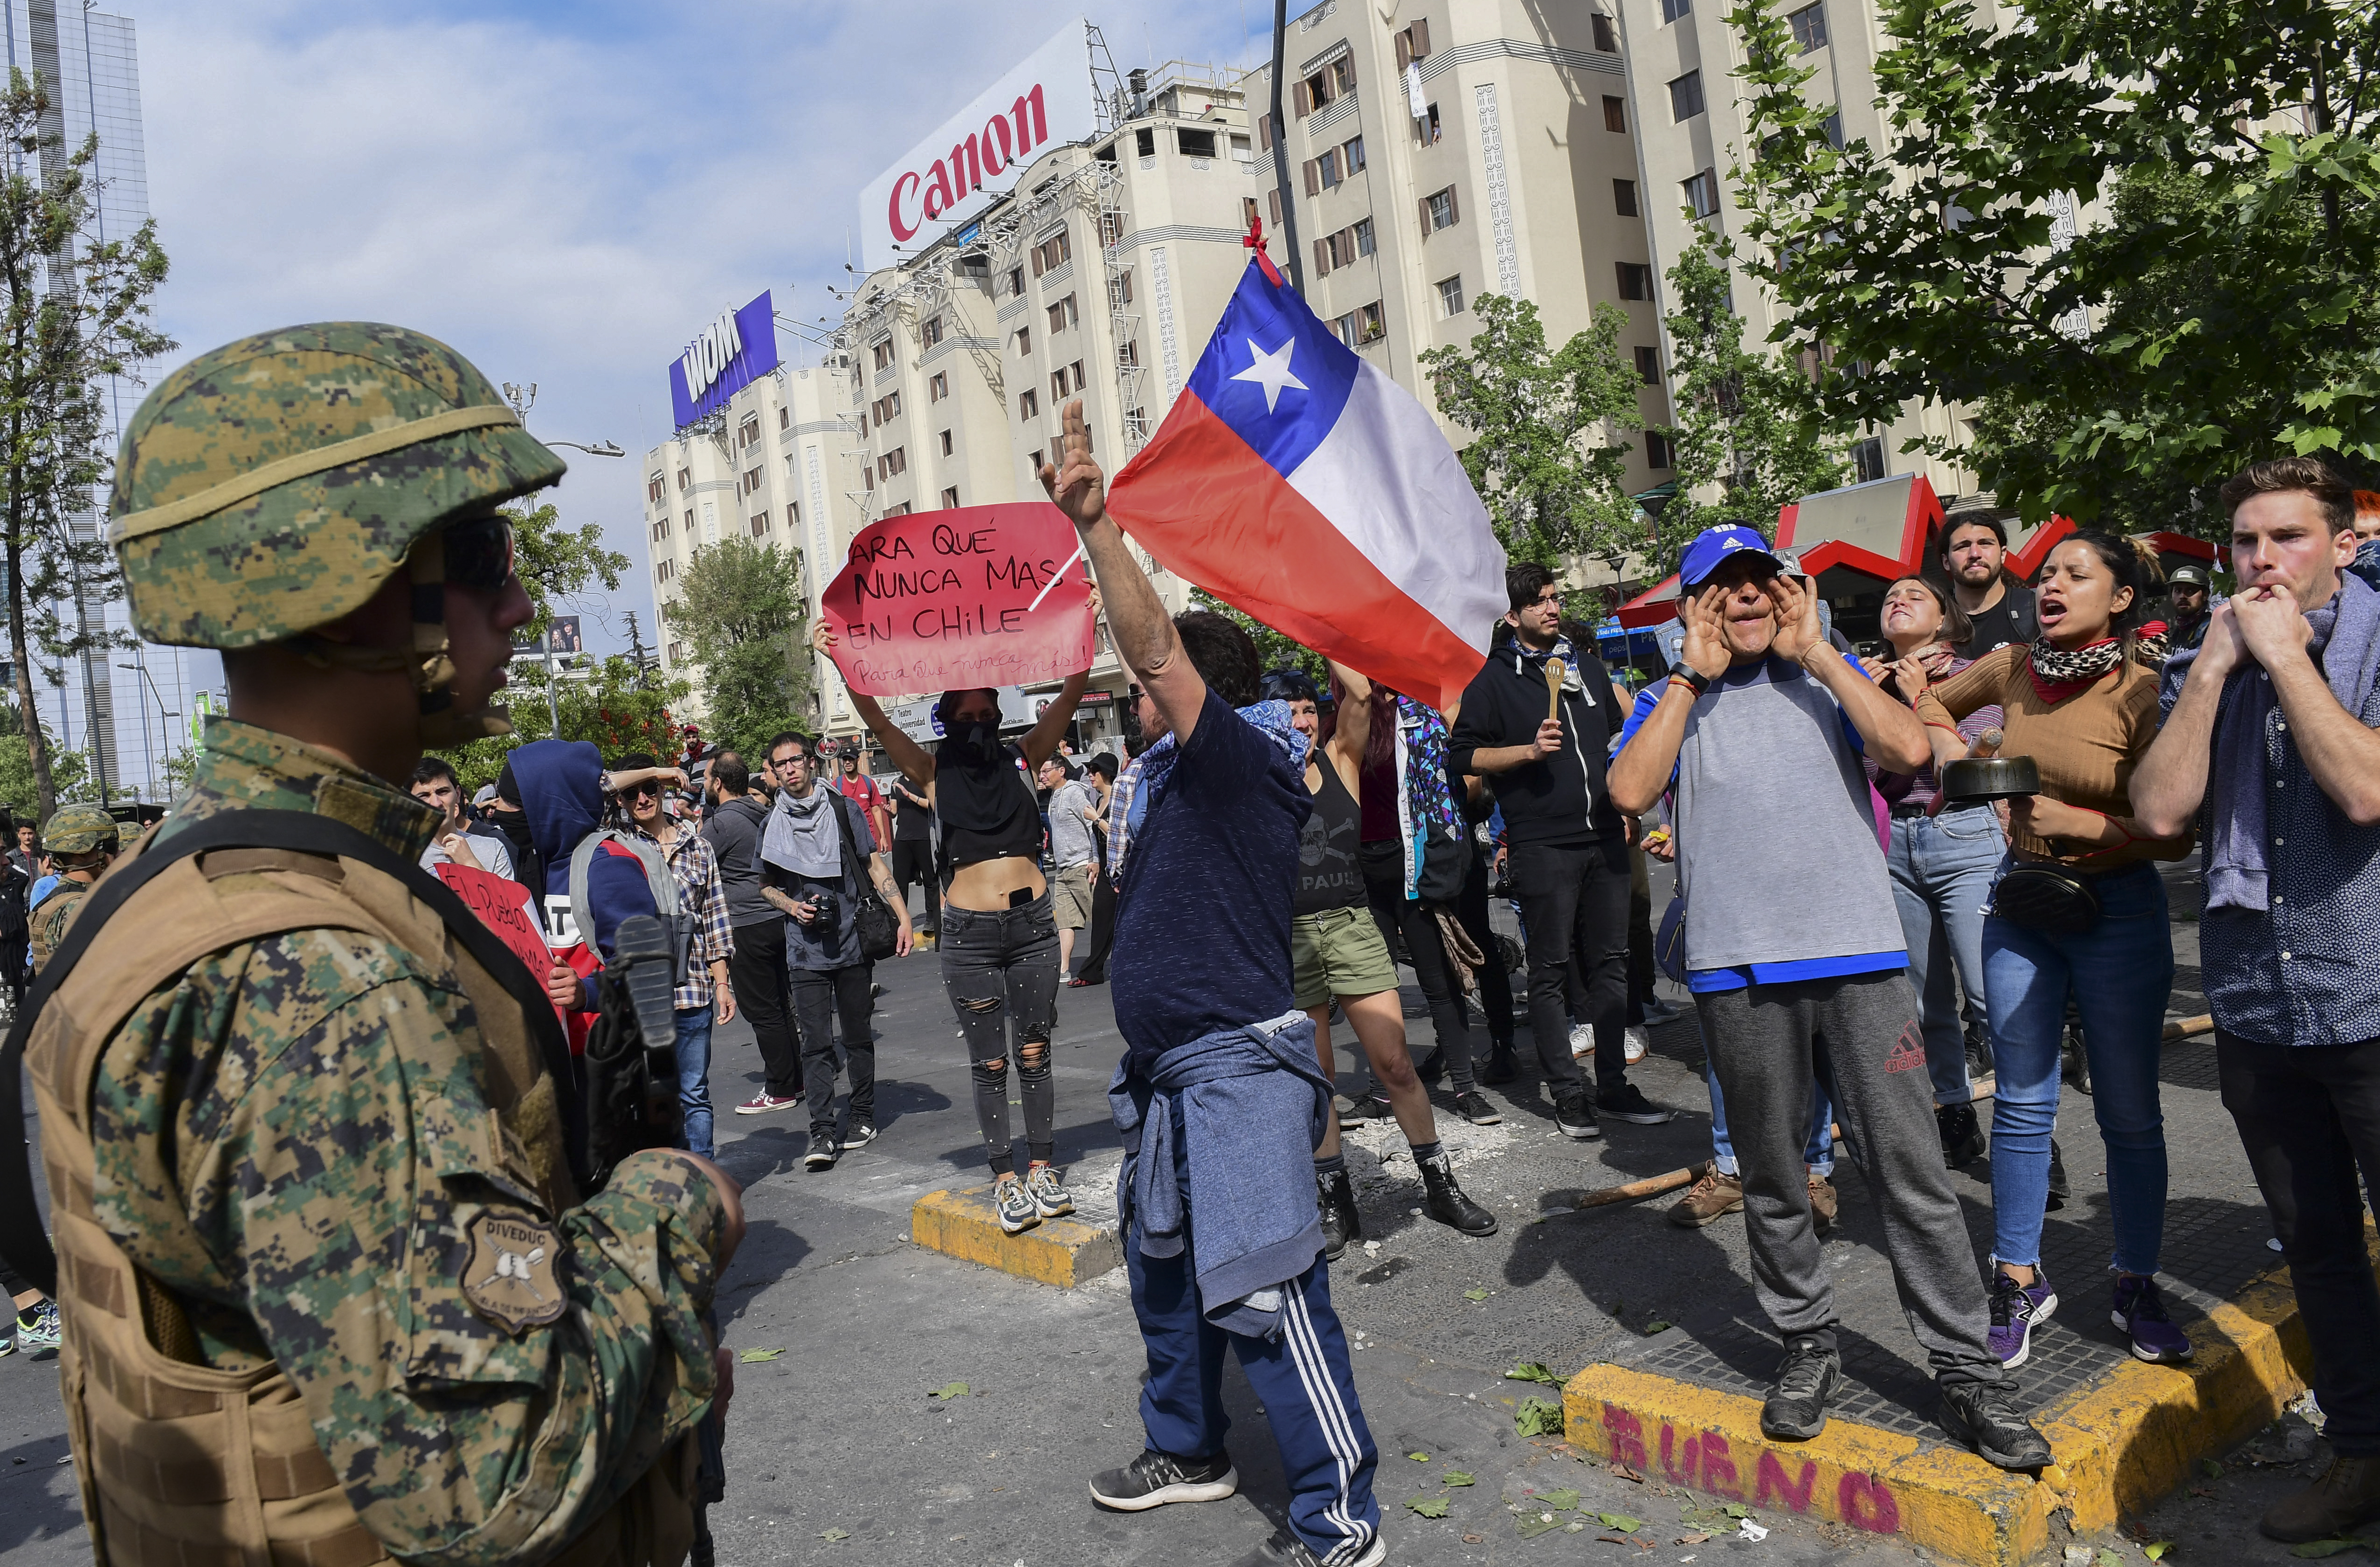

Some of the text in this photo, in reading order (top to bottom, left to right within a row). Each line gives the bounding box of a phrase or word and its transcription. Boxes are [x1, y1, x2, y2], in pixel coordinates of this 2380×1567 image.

[889, 83, 1048, 242] Canon
[683, 302, 741, 403] WOM
[848, 517, 996, 566] ARA QUÉ
[854, 569, 962, 605] NUNCA
[847, 614, 891, 650] EN
[1608, 645, 1628, 654] peps
[854, 660, 910, 686] Para
[952, 653, 1023, 670] nunca
[897, 709, 912, 718] Teatro
[899, 716, 925, 729] Universidad
[486, 1221, 546, 1246] DIVEDUC
[1603, 1403, 1900, 1534] BUENO
